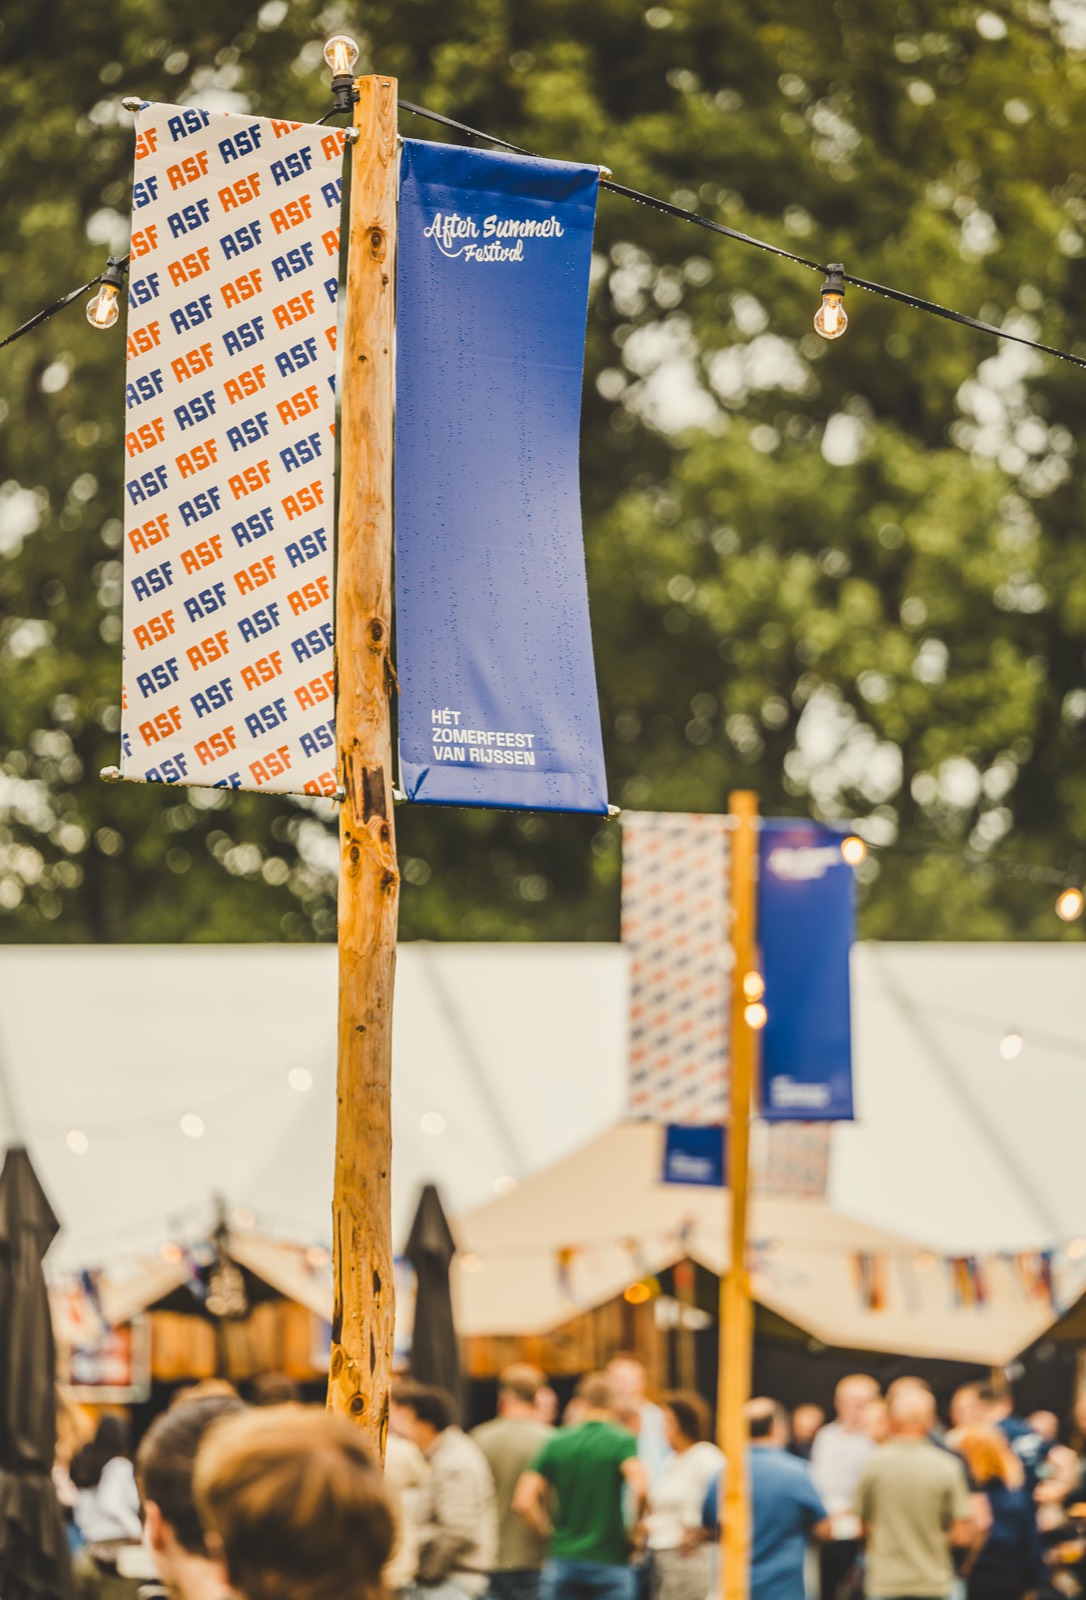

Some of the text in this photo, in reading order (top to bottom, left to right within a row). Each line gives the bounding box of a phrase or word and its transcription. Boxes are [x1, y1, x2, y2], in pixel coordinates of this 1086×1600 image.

[132, 176, 158, 211] SF
[166, 150, 208, 190] ASF
[218, 124, 261, 164] ASF
[168, 109, 210, 141] ASF
[130, 224, 158, 260] SF
[167, 198, 210, 238] ASF
[218, 172, 260, 212] ASF
[270, 146, 312, 186] ASF
[168, 247, 210, 286] ASF
[219, 220, 262, 260] ASF
[270, 194, 312, 234] ASF
[424, 213, 564, 249] After Summer
[170, 294, 212, 334] ASF
[220, 268, 262, 308] ASF
[271, 242, 314, 282] ASF
[463, 239, 524, 262] Festival
[126, 369, 164, 409] ASF
[171, 343, 213, 383] ASF
[222, 316, 265, 356] ASF
[272, 290, 314, 330] ASF
[125, 418, 164, 458] ASF
[174, 391, 216, 430] ASF
[224, 364, 266, 404] ASF
[274, 338, 318, 377] ASF
[126, 386, 318, 504] ASF ASF ASF ASF
[128, 433, 322, 554] ASF ASF ASF ASF
[132, 480, 323, 600] ASF ASF ASF ASF
[133, 528, 327, 650] ASF ASF ASF ASF
[136, 658, 178, 698] ASF
[186, 630, 228, 671] ASF
[237, 603, 280, 642] ASF
[288, 576, 329, 616] ASF
[139, 706, 182, 746] ASF
[190, 678, 234, 718] ASF
[240, 651, 282, 691] ASF
[291, 623, 334, 663] ASF
[194, 726, 236, 765] ASF
[244, 698, 288, 737] ASF
[294, 670, 334, 710] ASF
[431, 707, 461, 726] HÉT
[249, 746, 291, 785] ASF
[432, 727, 535, 748] ZOMERFEEST
[432, 745, 536, 766] VAN RIJSSEN
